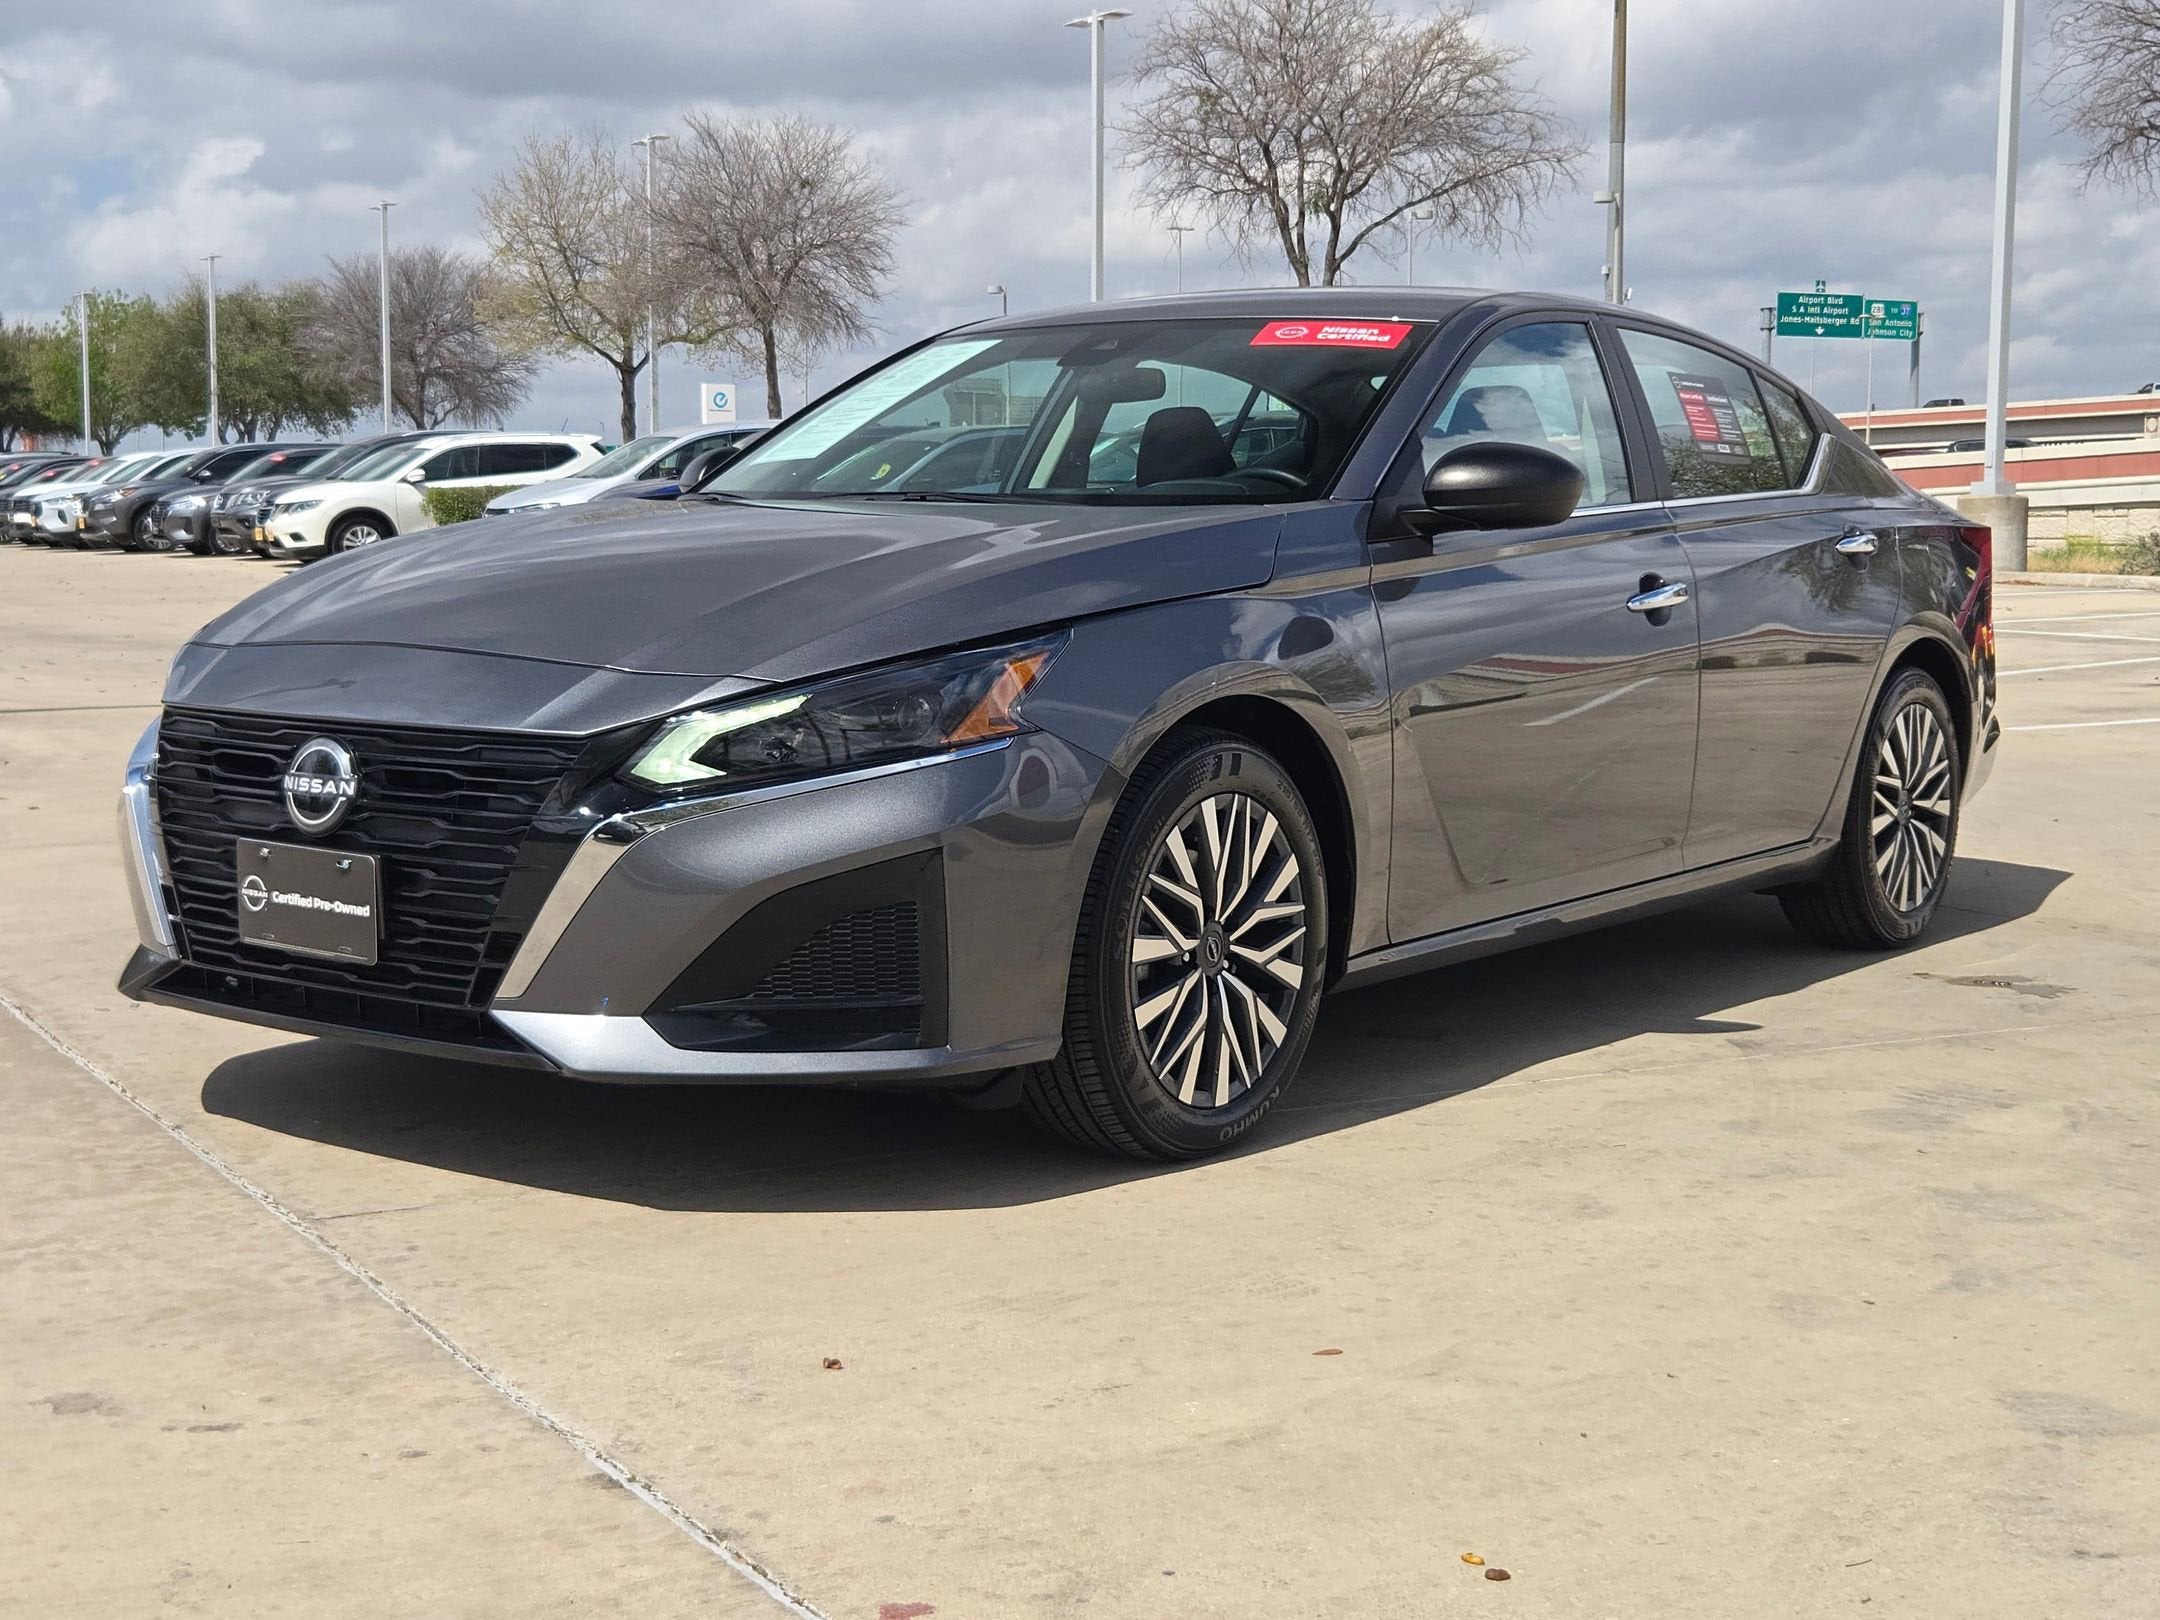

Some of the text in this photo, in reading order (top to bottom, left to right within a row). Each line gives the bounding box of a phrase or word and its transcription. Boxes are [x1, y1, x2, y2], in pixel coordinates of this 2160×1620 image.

[1799, 296, 1824, 304] Airport
[1792, 305, 1797, 313] S
[1823, 306, 1849, 315] Airport
[1322, 326, 1380, 335] Nissan
[1899, 329, 1913, 338] City
[1316, 333, 1392, 343] Certified
[284, 775, 355, 796] NISSAN
[242, 888, 268, 899] NISSAN
[272, 891, 371, 917] Certified Pre-Owned
